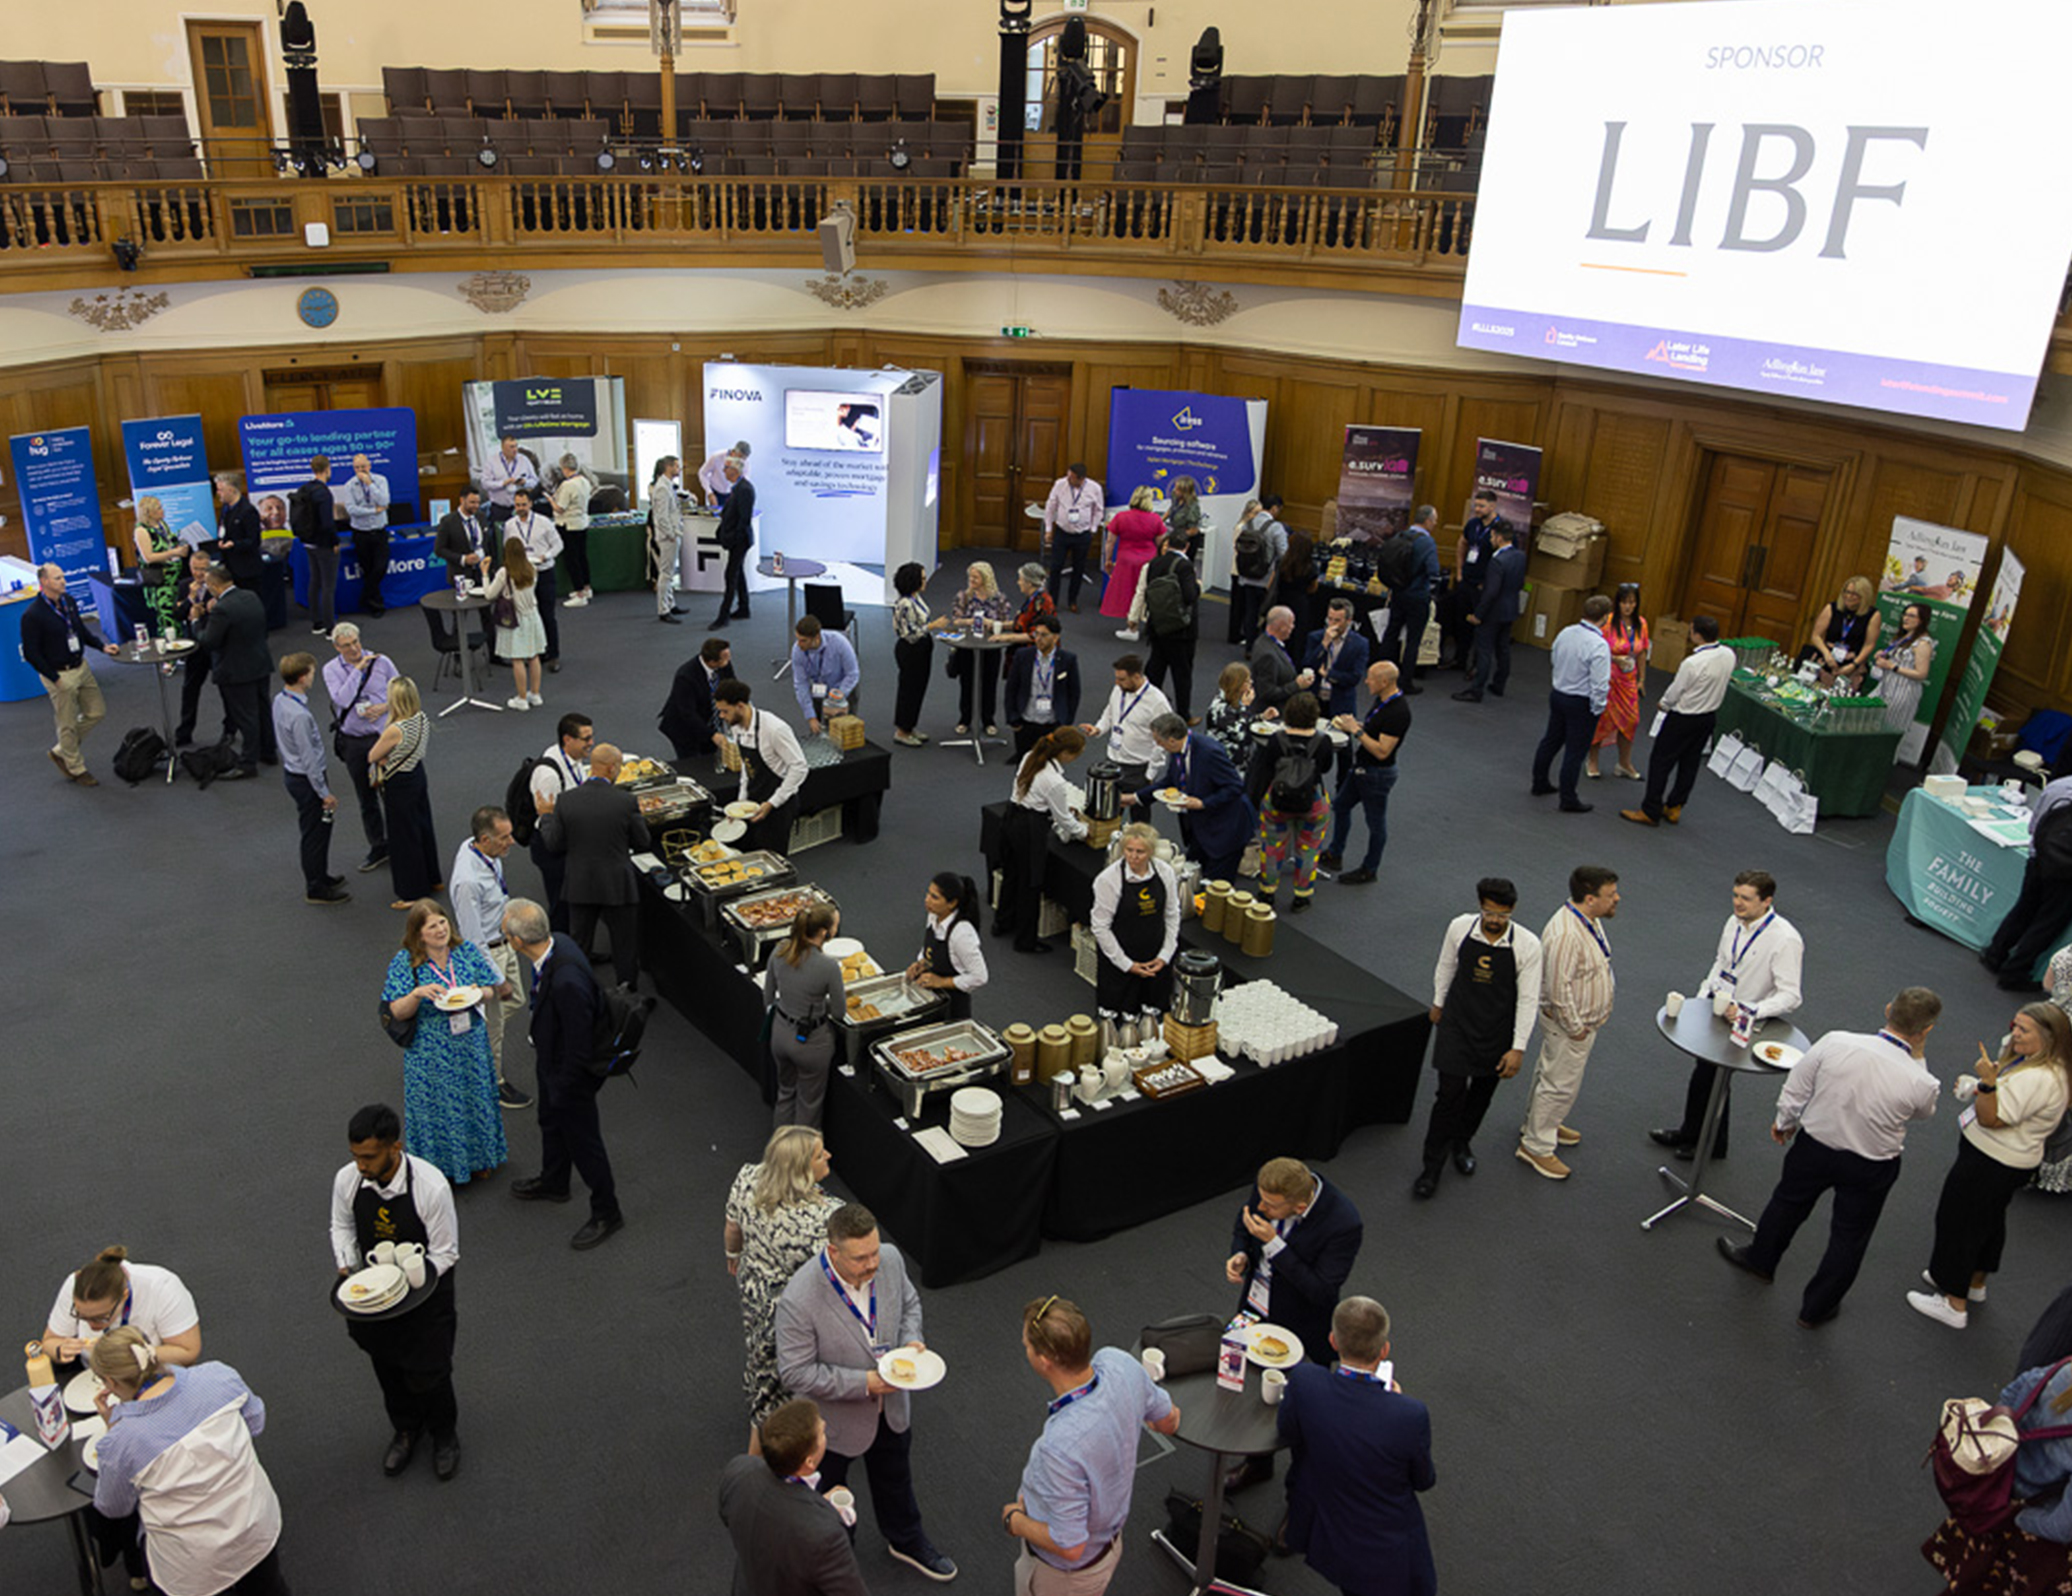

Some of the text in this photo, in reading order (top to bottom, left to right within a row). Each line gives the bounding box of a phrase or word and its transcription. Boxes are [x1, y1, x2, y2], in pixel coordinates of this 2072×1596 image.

[1705, 44, 1825, 69] SPONSOR
[1585, 121, 1930, 260] LIBF
[1667, 341, 1711, 355] Later Life
[710, 388, 762, 401] FINOVA
[140, 436, 194, 450] Forever Legal
[248, 429, 397, 446] Your go-to lending partner
[1152, 437, 1216, 450] Sourcing software
[250, 448, 267, 458] for
[270, 446, 284, 457] all
[286, 446, 319, 456] cases
[321, 445, 348, 455] ages
[847, 462, 873, 471] market
[1959, 850, 1983, 873] THE
[1927, 856, 1994, 905] FAMILY
[1927, 882, 1974, 914] BUILDING
[1923, 897, 1960, 921] SOCIETY
